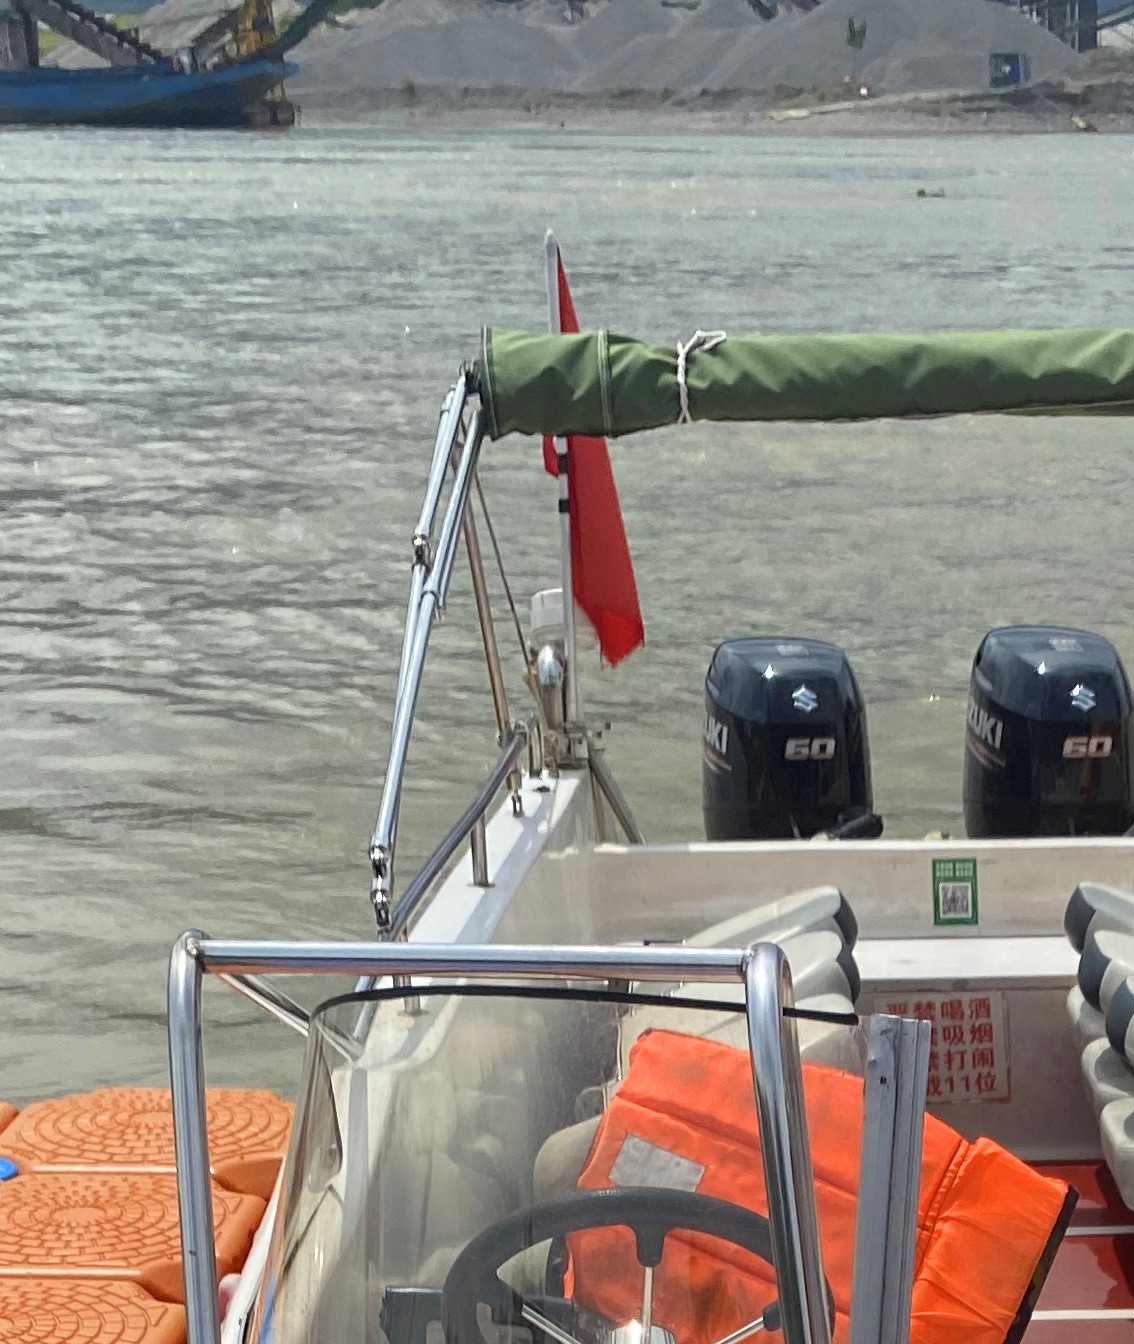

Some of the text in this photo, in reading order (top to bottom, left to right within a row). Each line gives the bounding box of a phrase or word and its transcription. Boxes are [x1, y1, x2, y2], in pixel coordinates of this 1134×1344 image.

[784, 737, 836, 760] 60
[1062, 735, 1113, 759] 60
[931, 1023, 993, 1046] 吸烟
